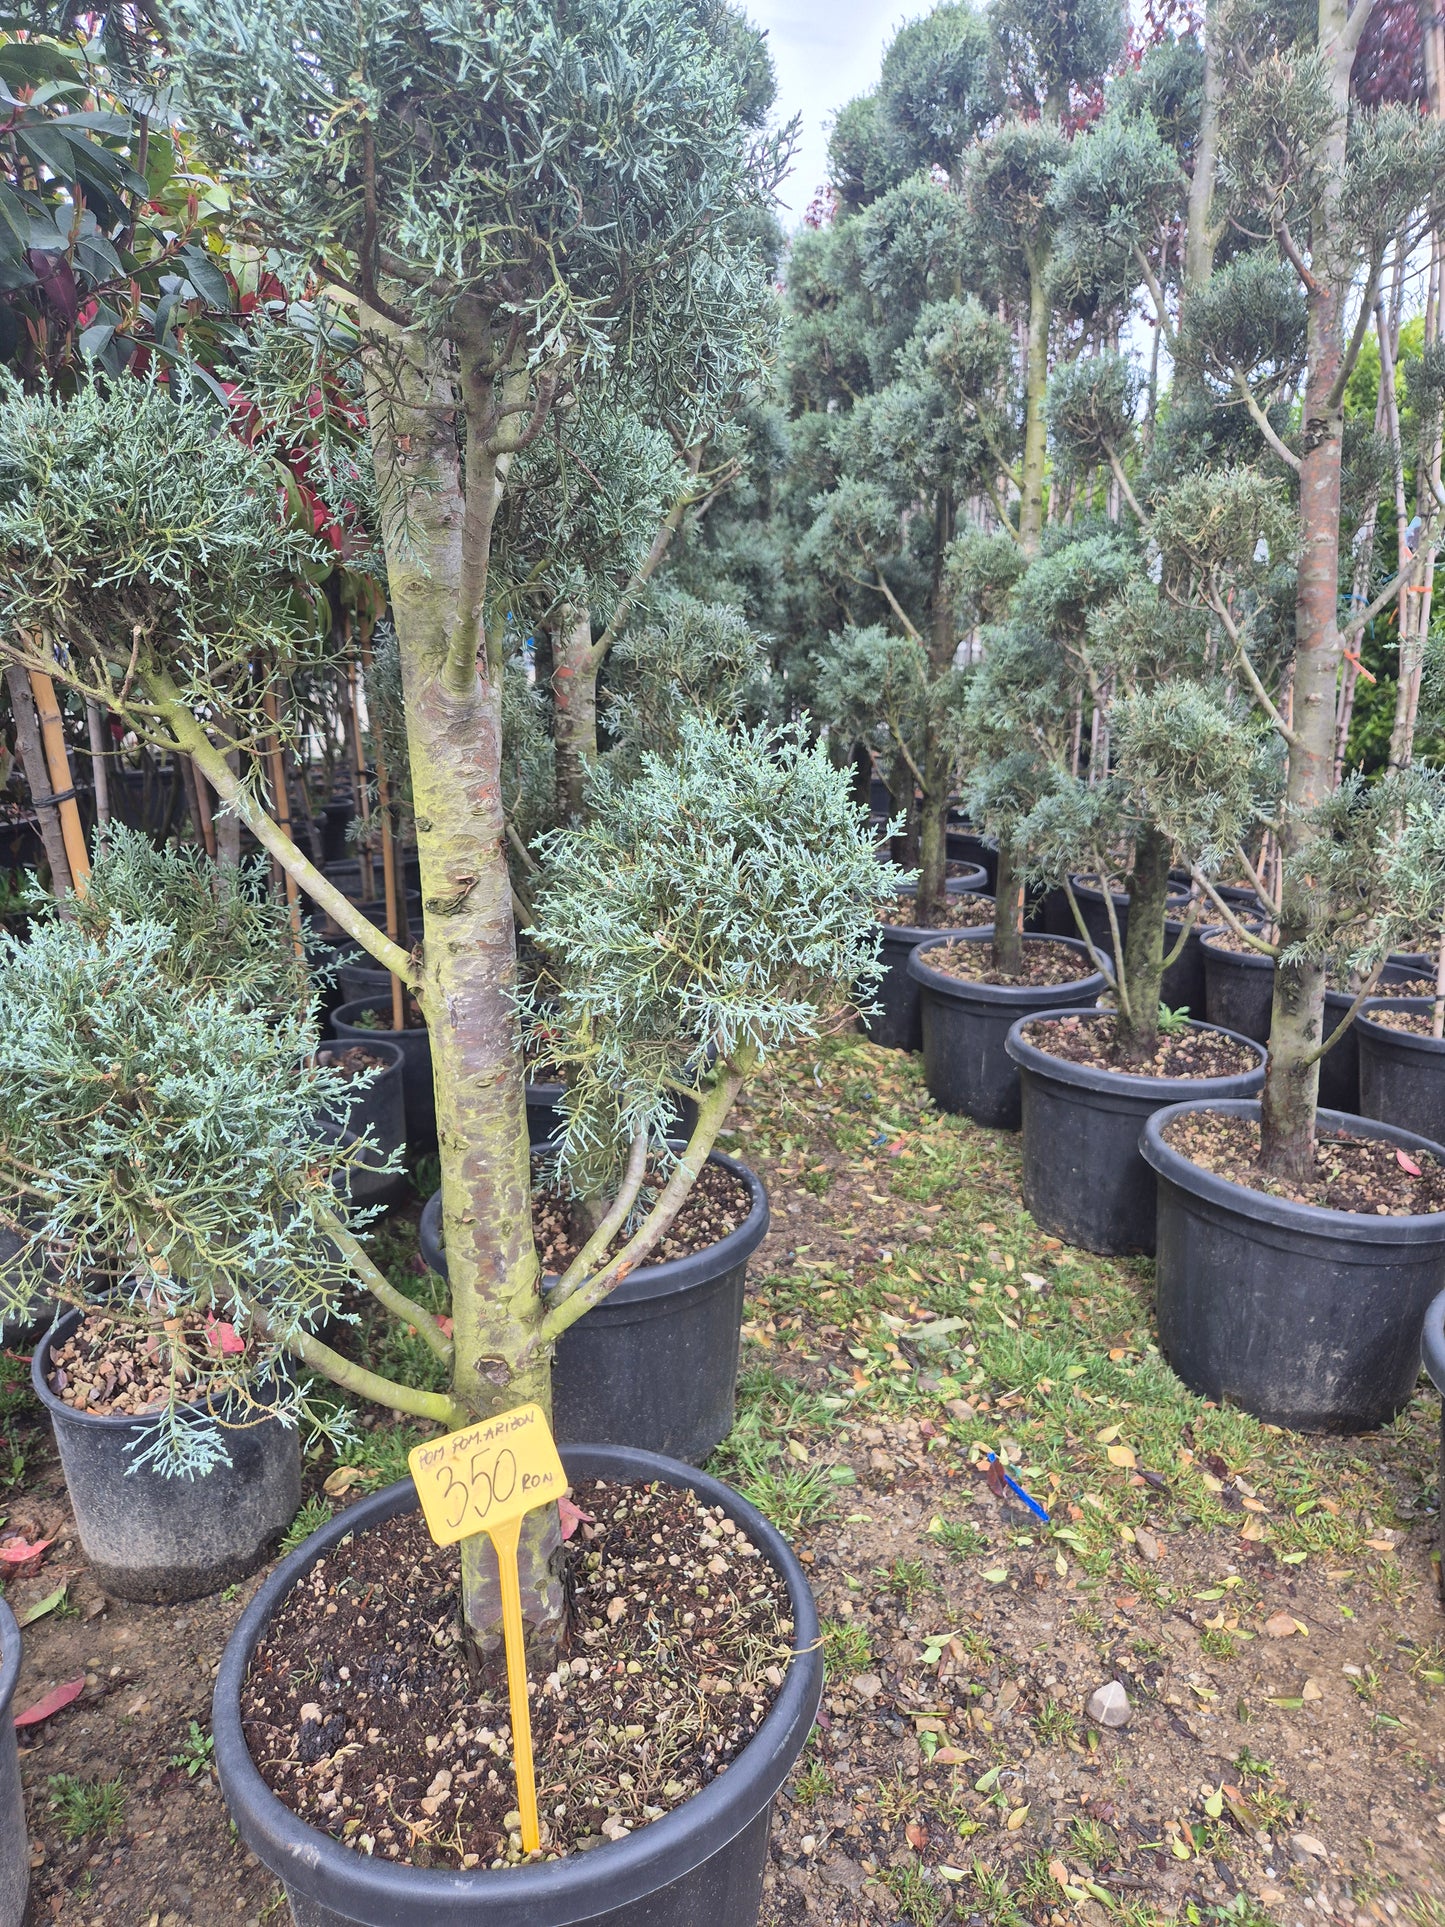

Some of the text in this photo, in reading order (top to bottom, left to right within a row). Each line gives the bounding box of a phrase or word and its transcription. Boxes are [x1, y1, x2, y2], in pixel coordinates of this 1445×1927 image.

[418, 1446, 445, 1470] POM
[436, 1448, 553, 1528] 350 RON
